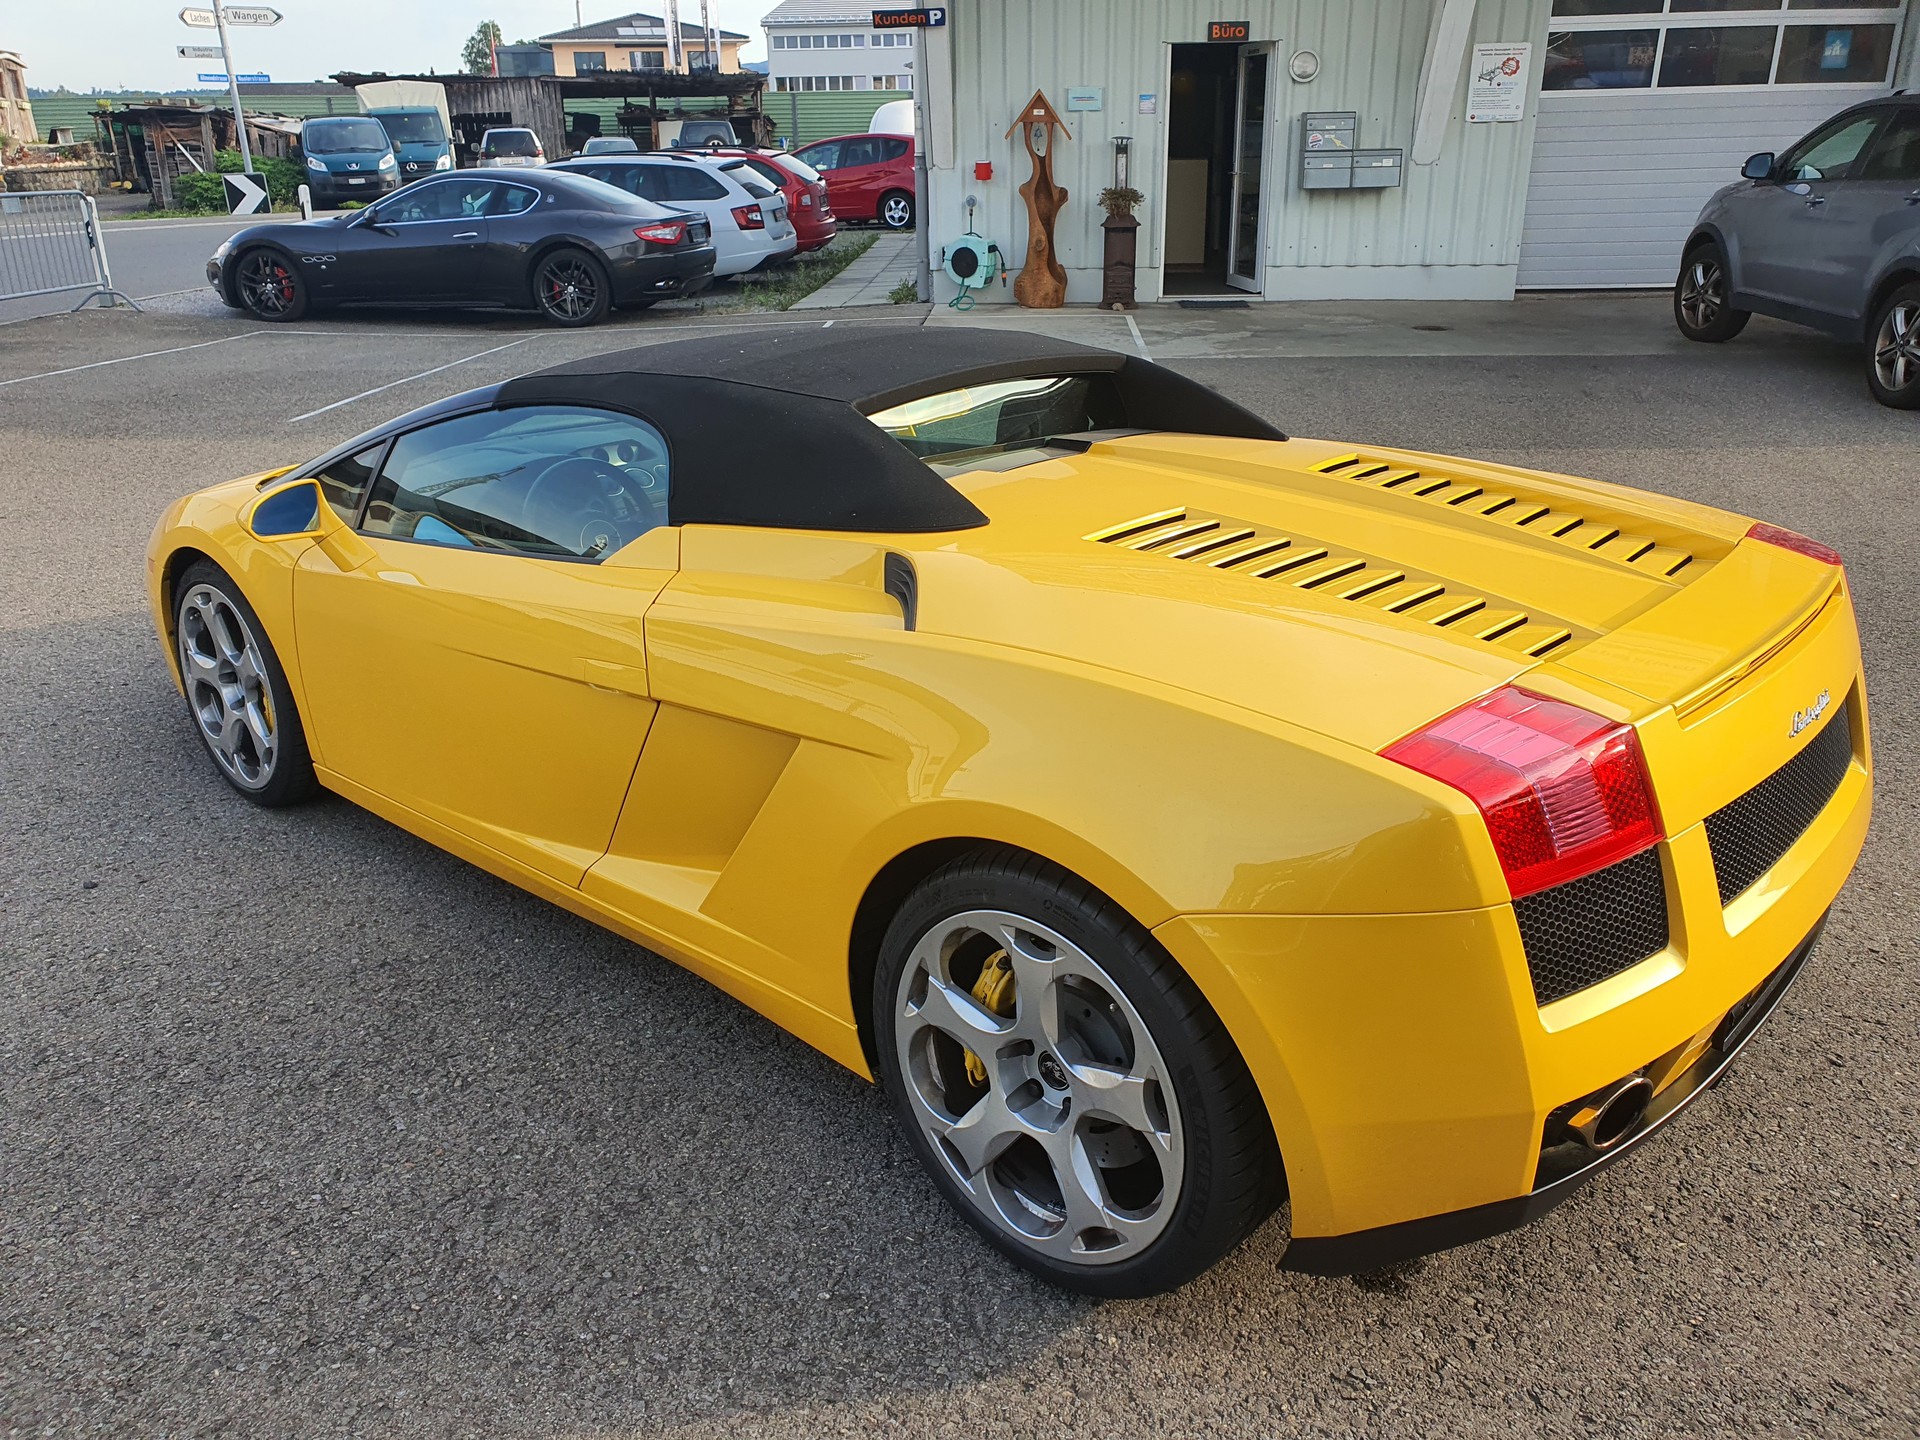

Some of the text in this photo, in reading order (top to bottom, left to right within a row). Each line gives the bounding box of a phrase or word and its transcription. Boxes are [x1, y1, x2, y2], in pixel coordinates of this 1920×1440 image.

[189, 12, 211, 23] Lachen
[231, 10, 269, 23] Wangen
[874, 10, 942, 25] Kunden P
[1212, 23, 1245, 38] Büro
